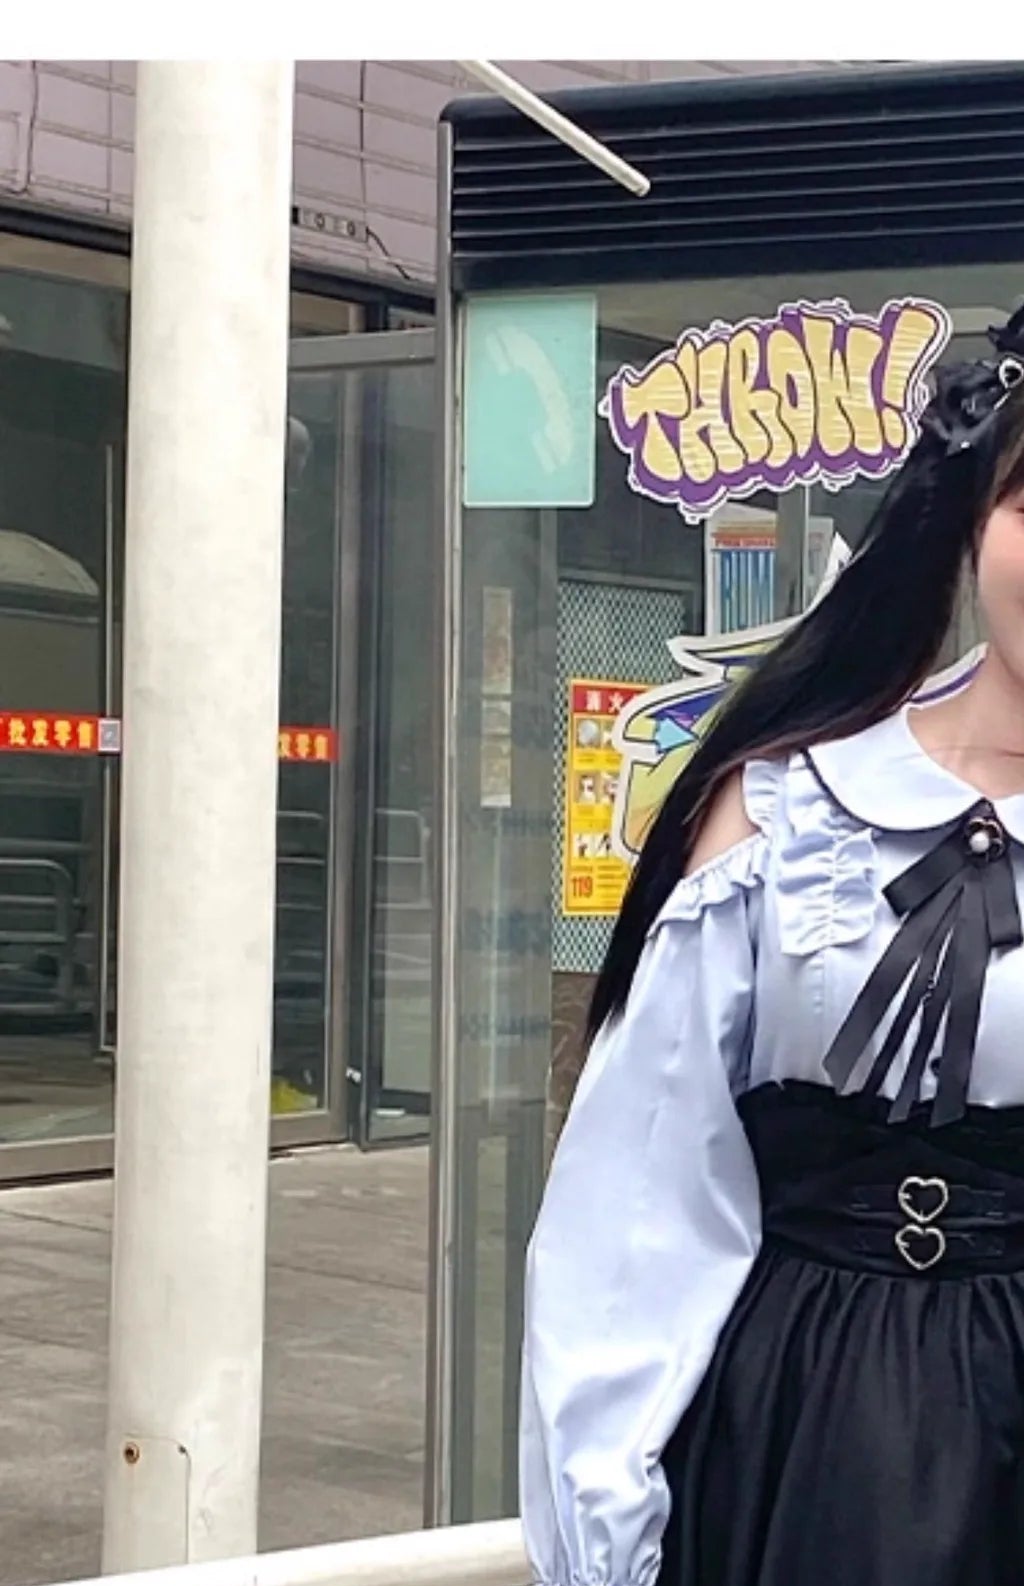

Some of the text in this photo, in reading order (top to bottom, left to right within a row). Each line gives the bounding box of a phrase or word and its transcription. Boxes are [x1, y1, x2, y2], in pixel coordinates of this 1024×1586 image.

[612, 303, 938, 494] THROW!
[0, 718, 93, 748] 批发零售
[571, 875, 594, 898] 119
